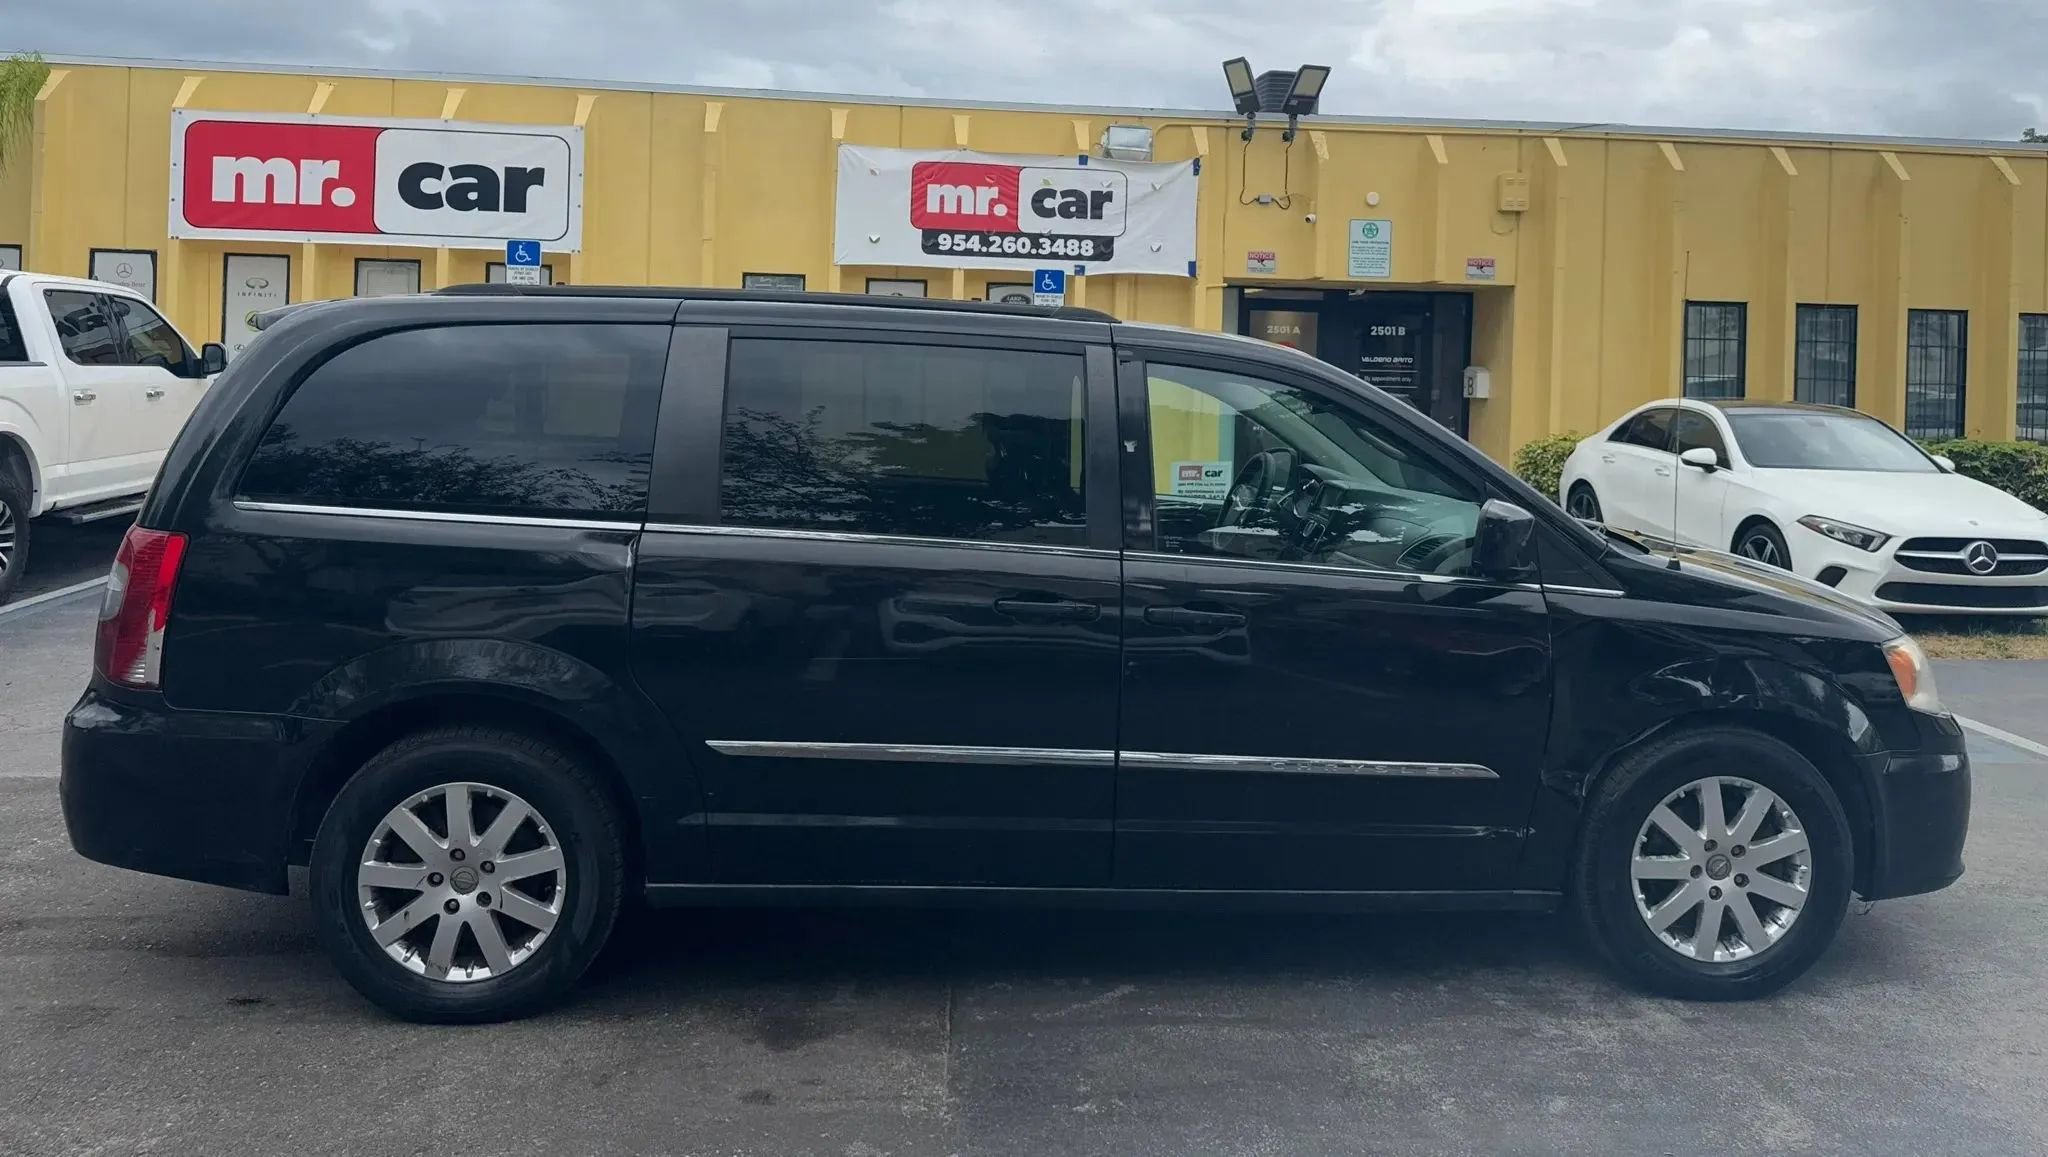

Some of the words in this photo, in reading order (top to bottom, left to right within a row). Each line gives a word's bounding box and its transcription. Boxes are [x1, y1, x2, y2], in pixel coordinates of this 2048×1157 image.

[212, 155, 356, 207] mr.
[397, 161, 545, 213] car
[926, 184, 1008, 217] mr.
[1031, 187, 1114, 220] car
[937, 233, 1095, 257] 954.260.3488
[1249, 251, 1275, 259] NOTICE
[1467, 258, 1494, 266] NOTICE
[1266, 325, 1291, 335] 2501
[1291, 325, 1301, 335] A
[1370, 326, 1397, 336] 2501
[1397, 326, 1406, 336] B
[1467, 376, 1474, 396] B
[1181, 470, 1200, 478] mr.
[1204, 470, 1223, 478] car
[1271, 761, 1465, 775] CHRYSLER
